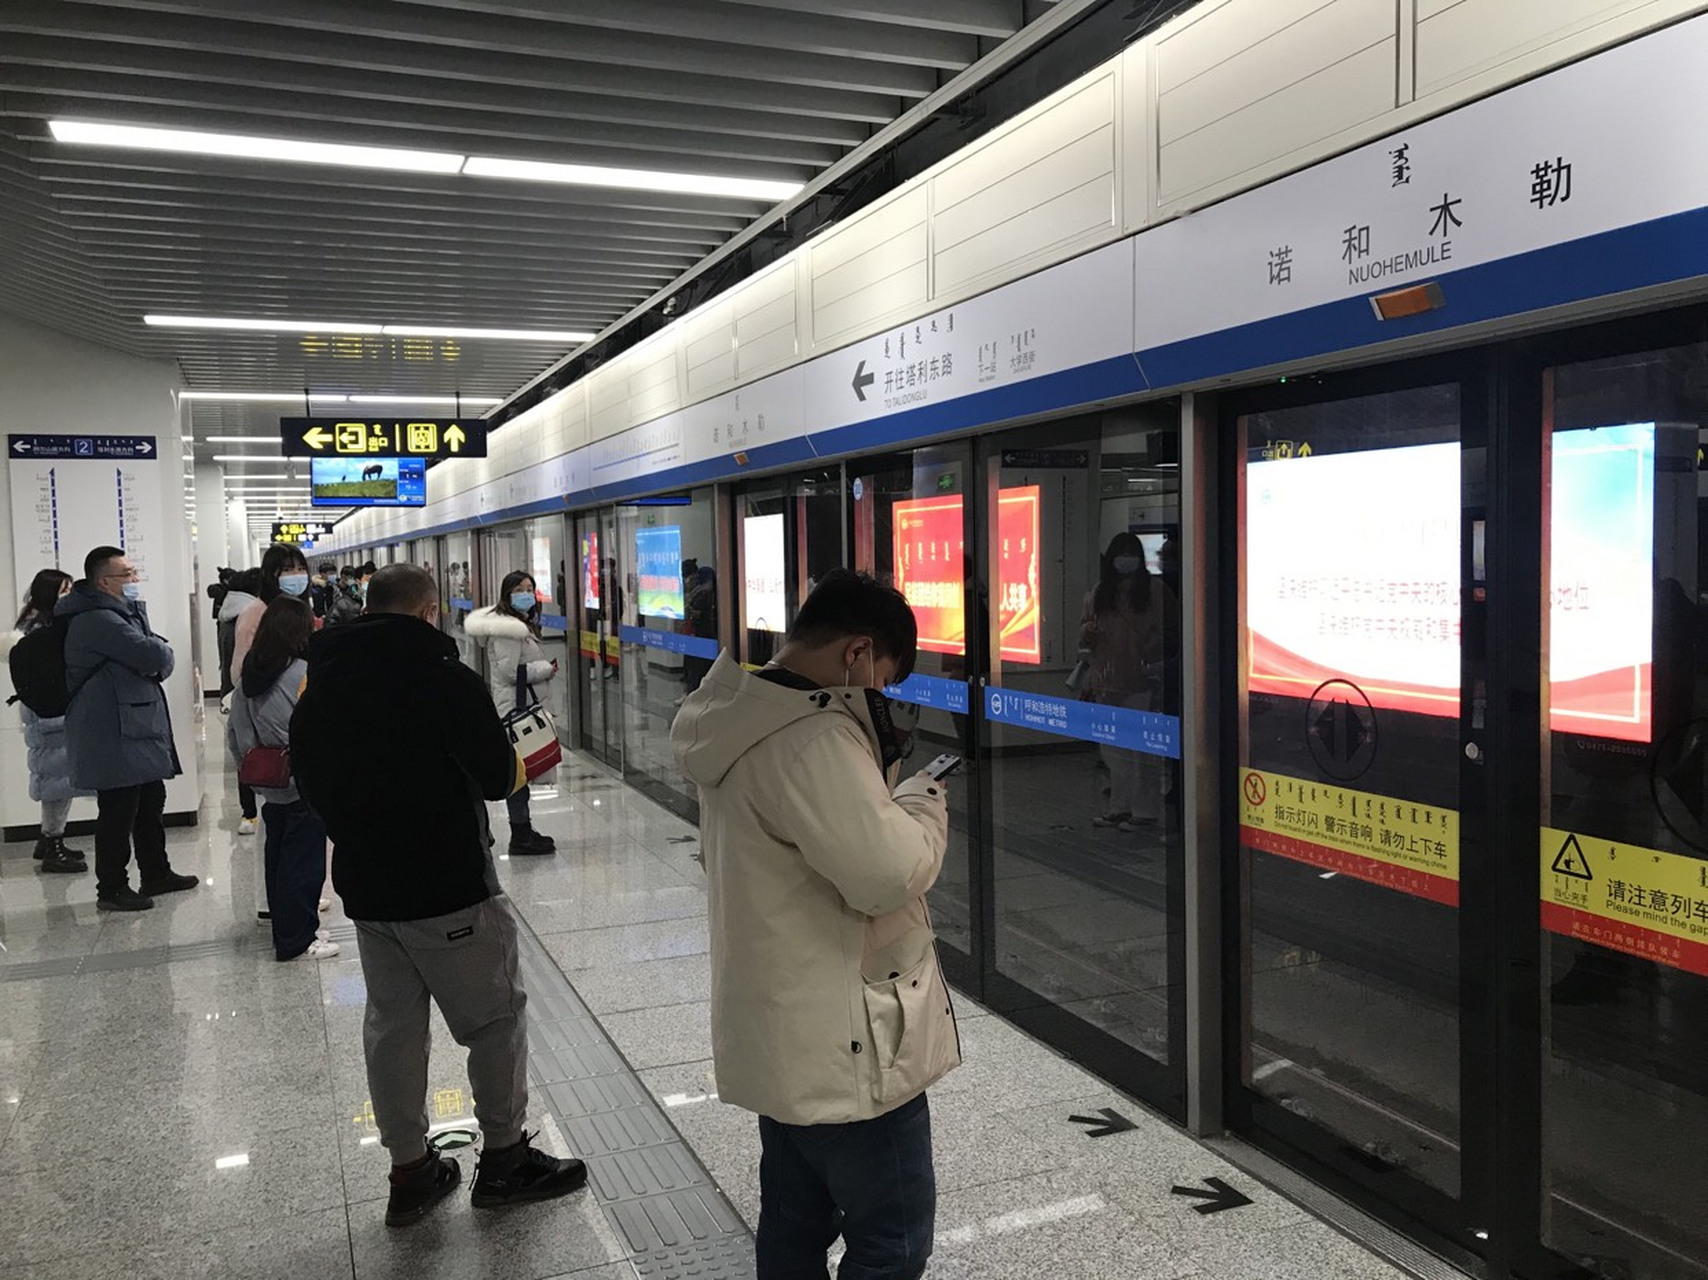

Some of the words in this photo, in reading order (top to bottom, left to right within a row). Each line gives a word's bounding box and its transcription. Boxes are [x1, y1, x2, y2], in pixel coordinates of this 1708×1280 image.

[1267, 156, 1572, 286] 诺和木勒
[1348, 241, 1453, 285] NUOHEMULE
[883, 352, 954, 395] 开往塔利东路
[79, 440, 89, 454] 2
[368, 436, 389, 447] 出口
[1024, 699, 1067, 718] 呼和浩特地铁
[1048, 718, 1068, 729] METRO
[1274, 804, 1319, 829] 指示灯闪
[1324, 815, 1373, 843] 警示音响
[1379, 829, 1448, 860] 请勿上下车
[1606, 878, 1708, 924] 请注意列车
[1606, 899, 1641, 917] Please
[1643, 909, 1668, 925] mind
[1670, 916, 1687, 930] the
